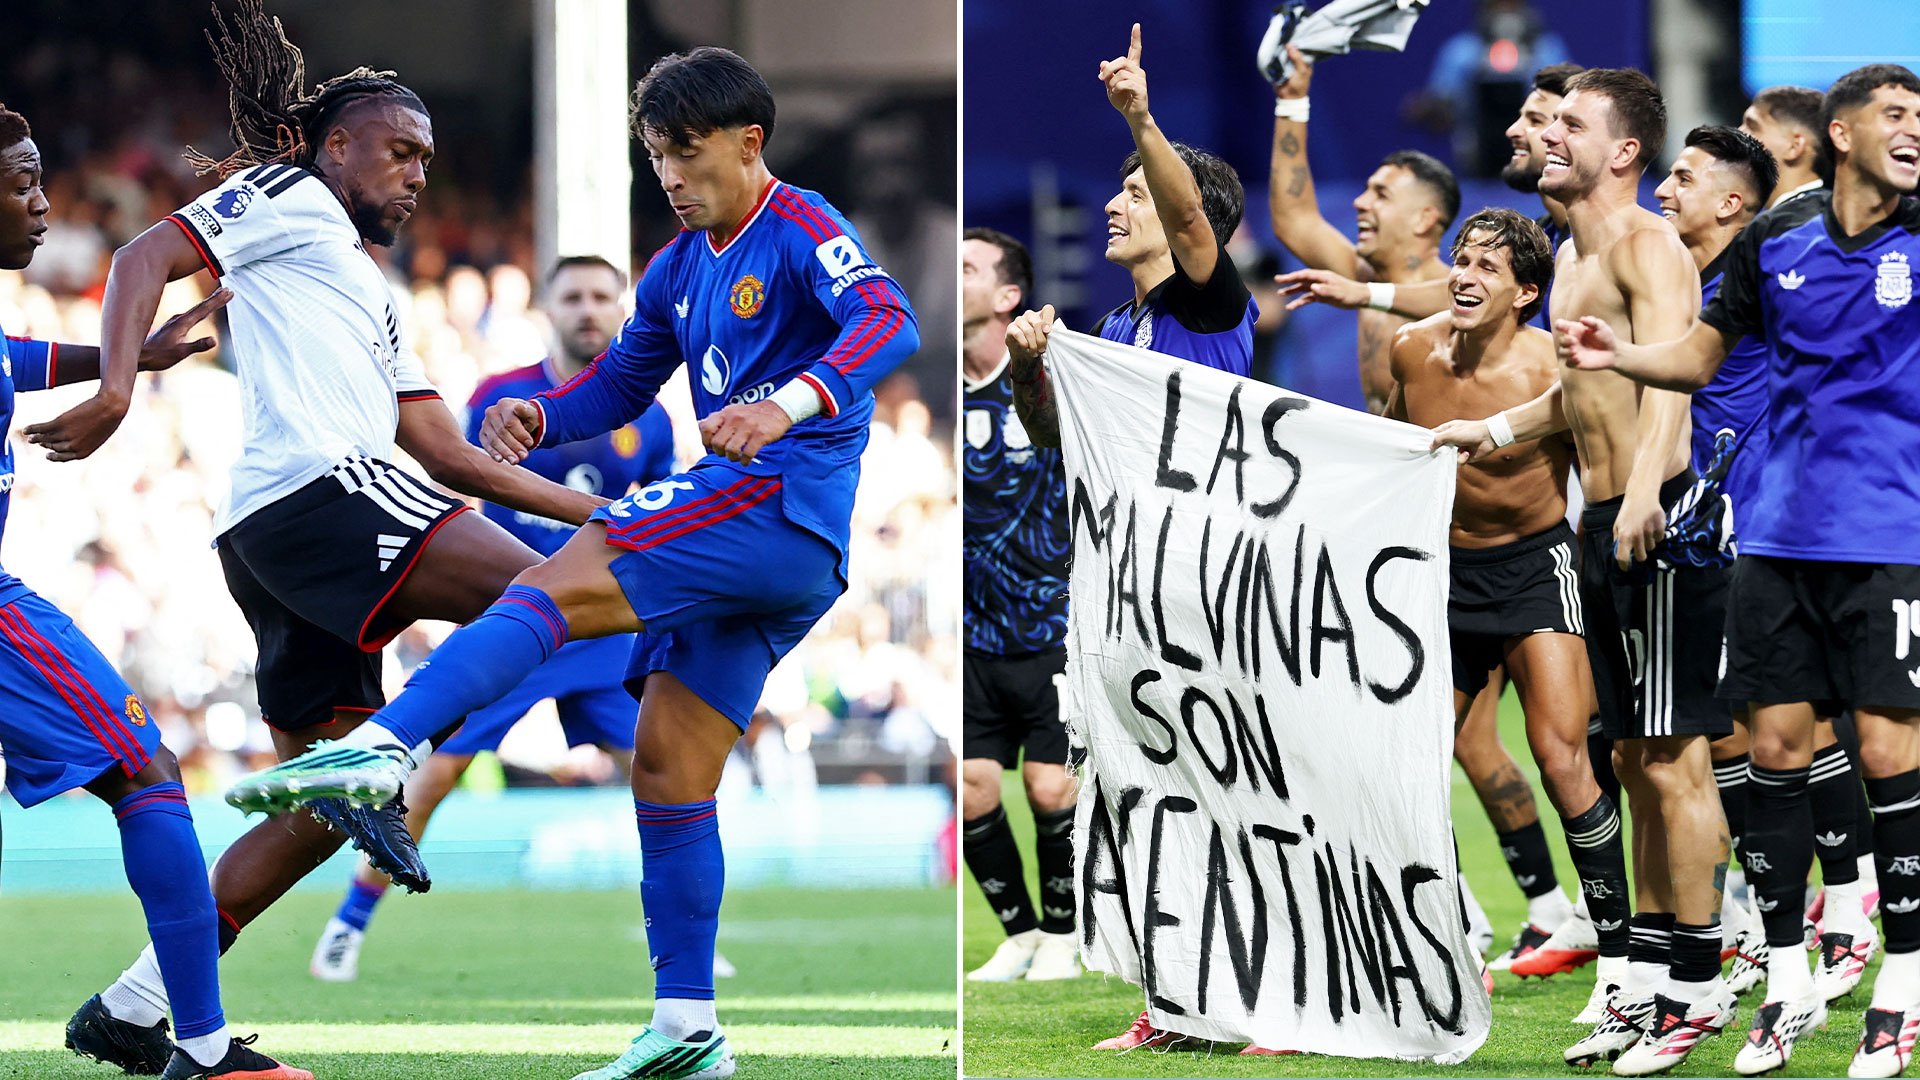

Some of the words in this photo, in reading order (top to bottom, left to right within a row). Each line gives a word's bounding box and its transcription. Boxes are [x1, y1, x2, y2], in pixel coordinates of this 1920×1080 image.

[633, 481, 695, 511] 6
[1156, 366, 1311, 519] LAS
[1070, 476, 1437, 705] MALVINAS
[1131, 668, 1290, 801] SON
[1582, 878, 1613, 899] AFA
